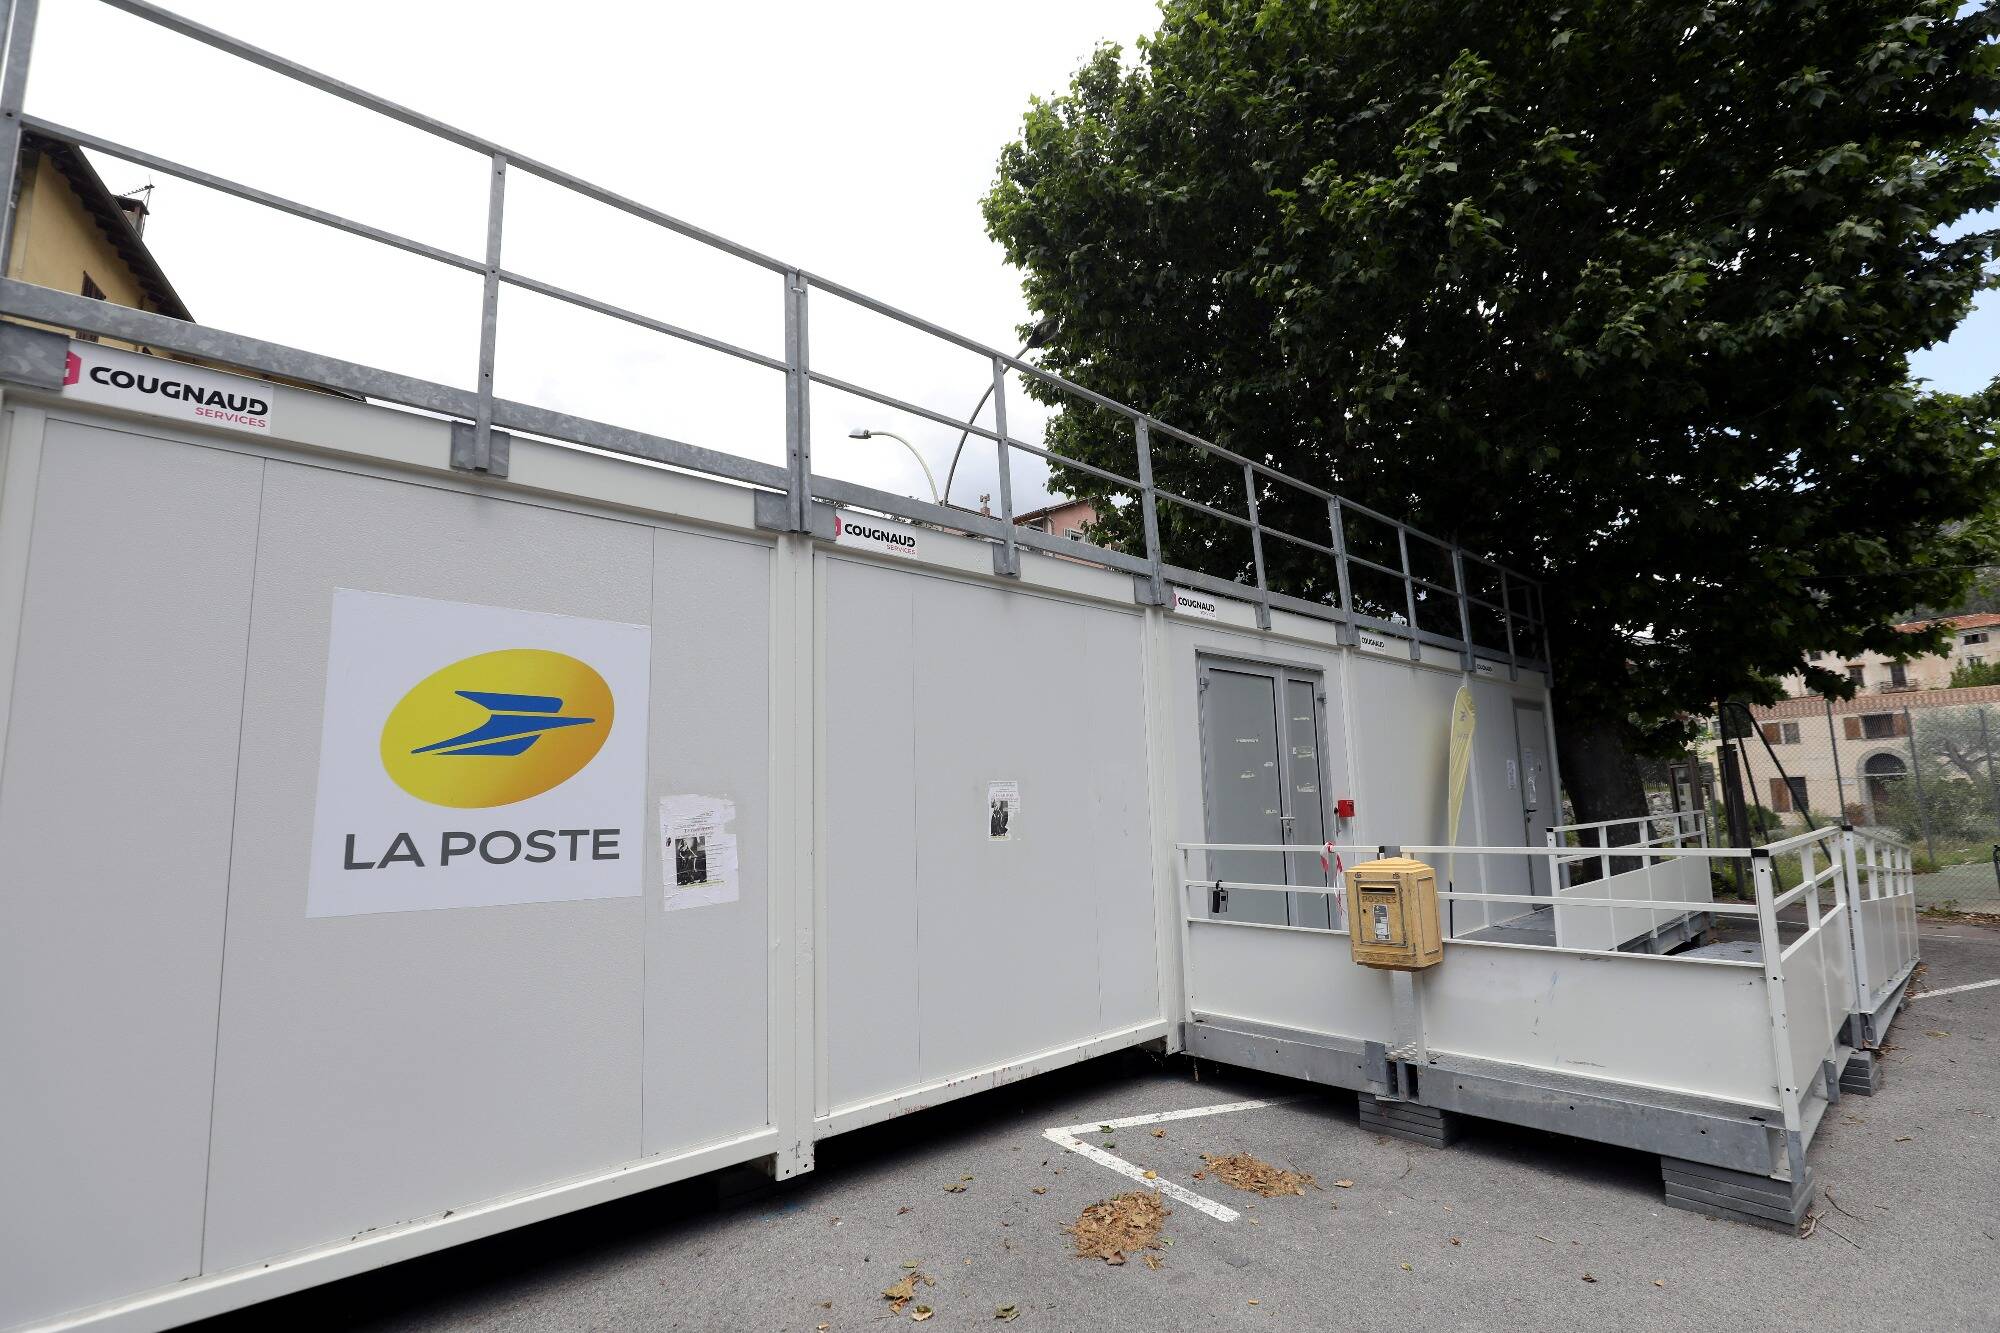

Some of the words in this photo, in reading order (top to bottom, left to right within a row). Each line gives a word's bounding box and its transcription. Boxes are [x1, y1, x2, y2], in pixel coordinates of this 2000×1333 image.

[90, 366, 268, 416] COUGNAUD
[194, 407, 266, 428] SERVICES
[844, 523, 916, 547] COUGNAUD
[1178, 597, 1215, 612] COUGNAUD
[343, 832, 425, 870] LA
[440, 828, 621, 866] POSTE
[1361, 895, 1397, 904] POSTES
